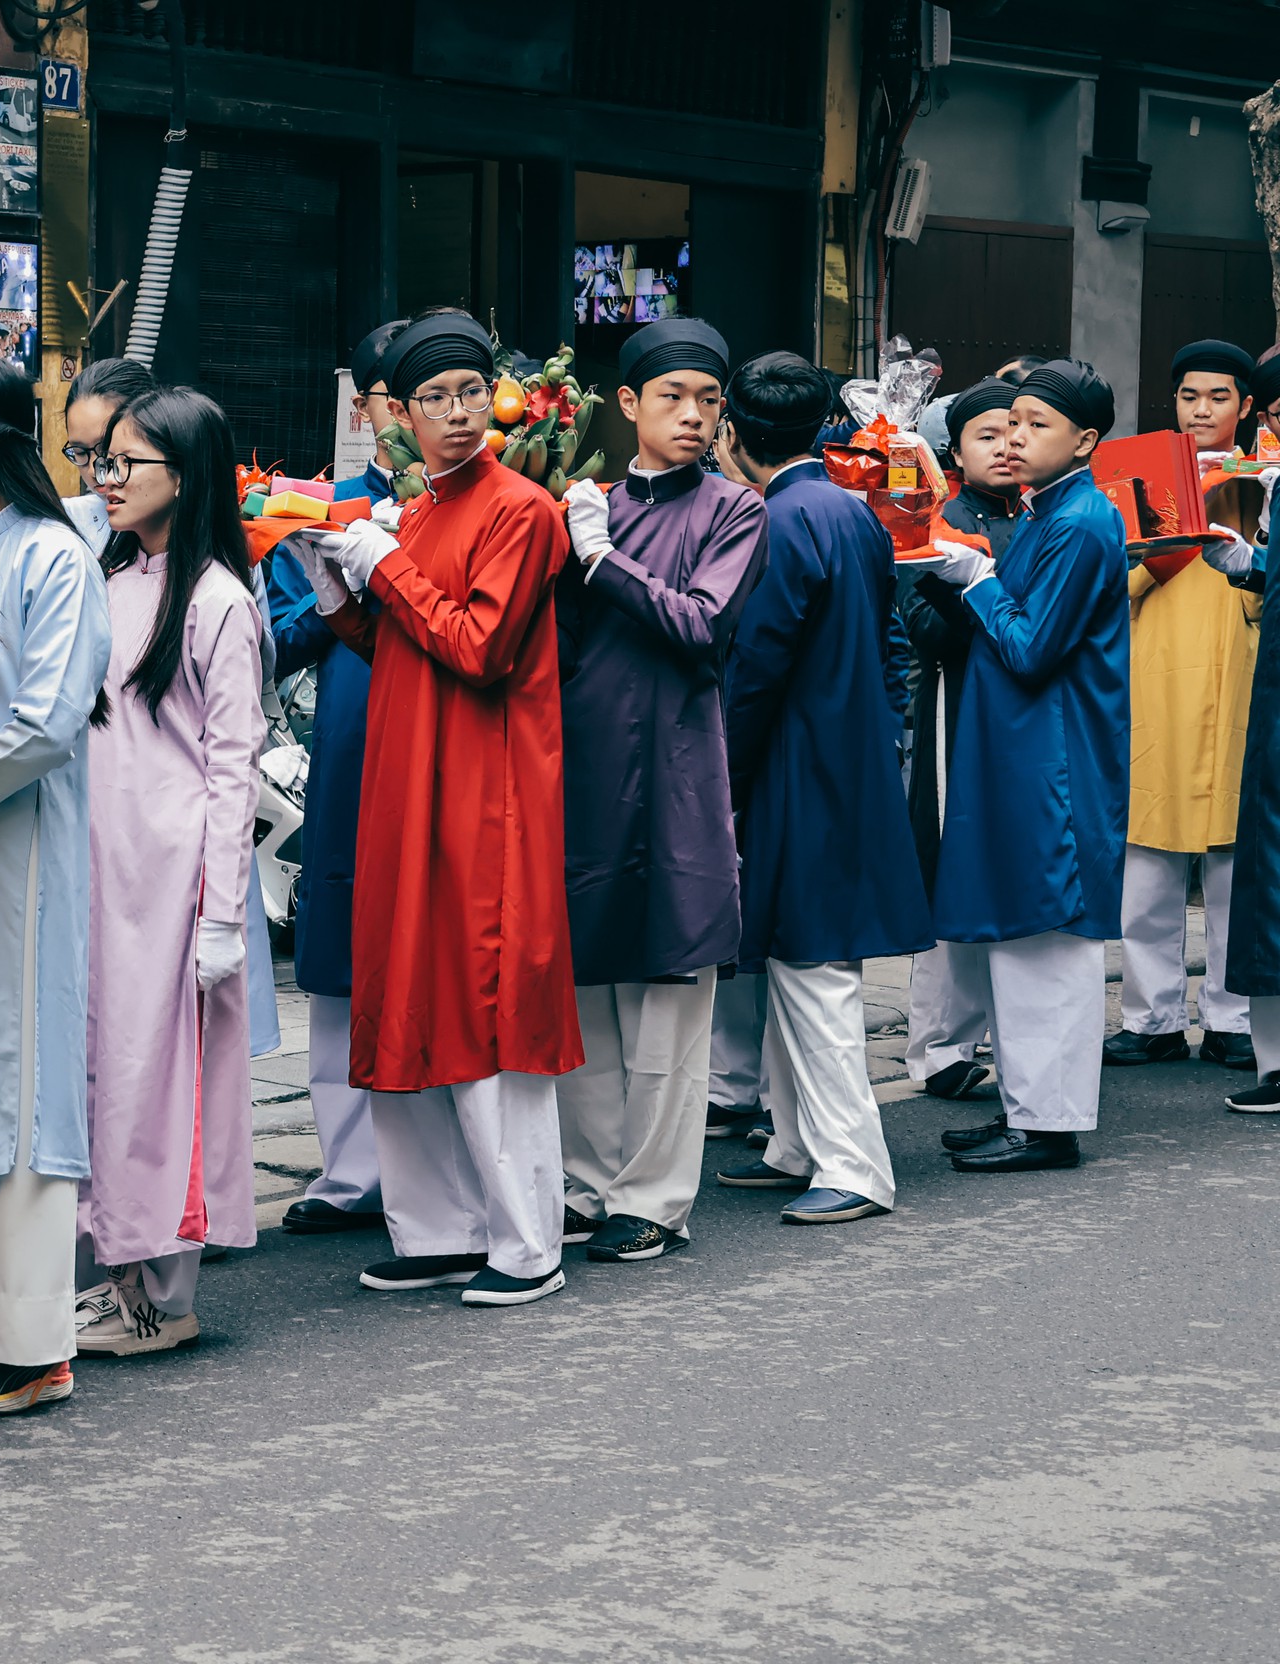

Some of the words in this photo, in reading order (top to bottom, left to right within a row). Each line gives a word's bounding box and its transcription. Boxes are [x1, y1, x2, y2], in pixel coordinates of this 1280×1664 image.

[5, 78, 26, 88] TICKET
[45, 66, 71, 99] 87
[133, 1302, 161, 1340] NY
